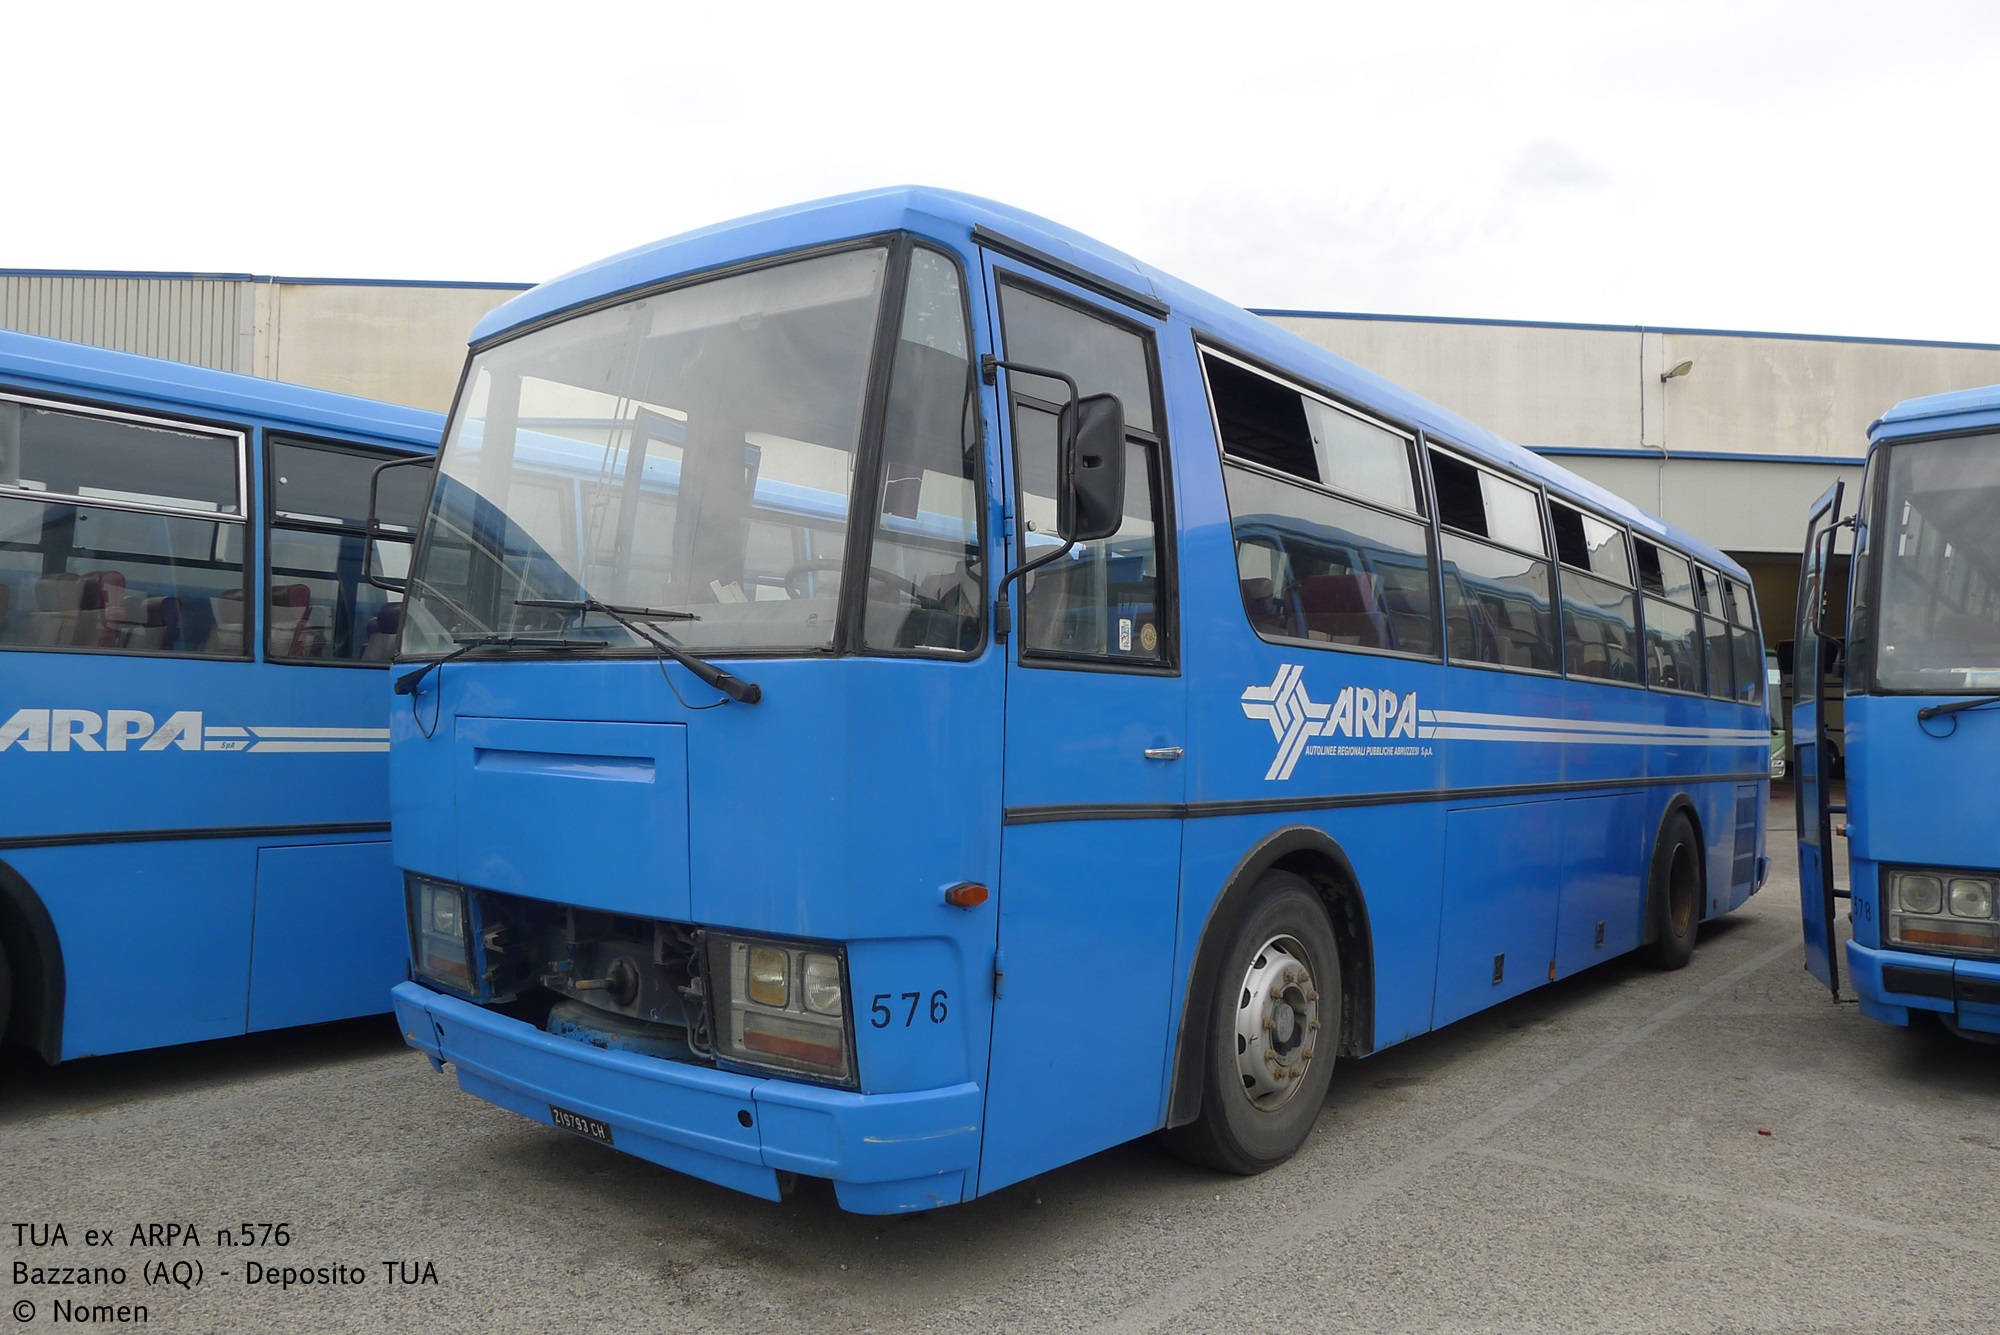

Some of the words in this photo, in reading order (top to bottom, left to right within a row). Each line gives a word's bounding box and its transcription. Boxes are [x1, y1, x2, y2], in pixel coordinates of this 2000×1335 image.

[1321, 686, 1417, 738] ARPA
[0, 709, 203, 752] ARPA
[220, 741, 236, 749] SpA
[1305, 745, 1337, 756] AUTOLINEE
[1337, 746, 1366, 756] REGIONALI
[1366, 747, 1394, 756] PUBBLICHE
[1394, 746, 1420, 756] ABRUZZESI
[871, 990, 948, 1028] 576
[590, 1123, 606, 1139] CH
